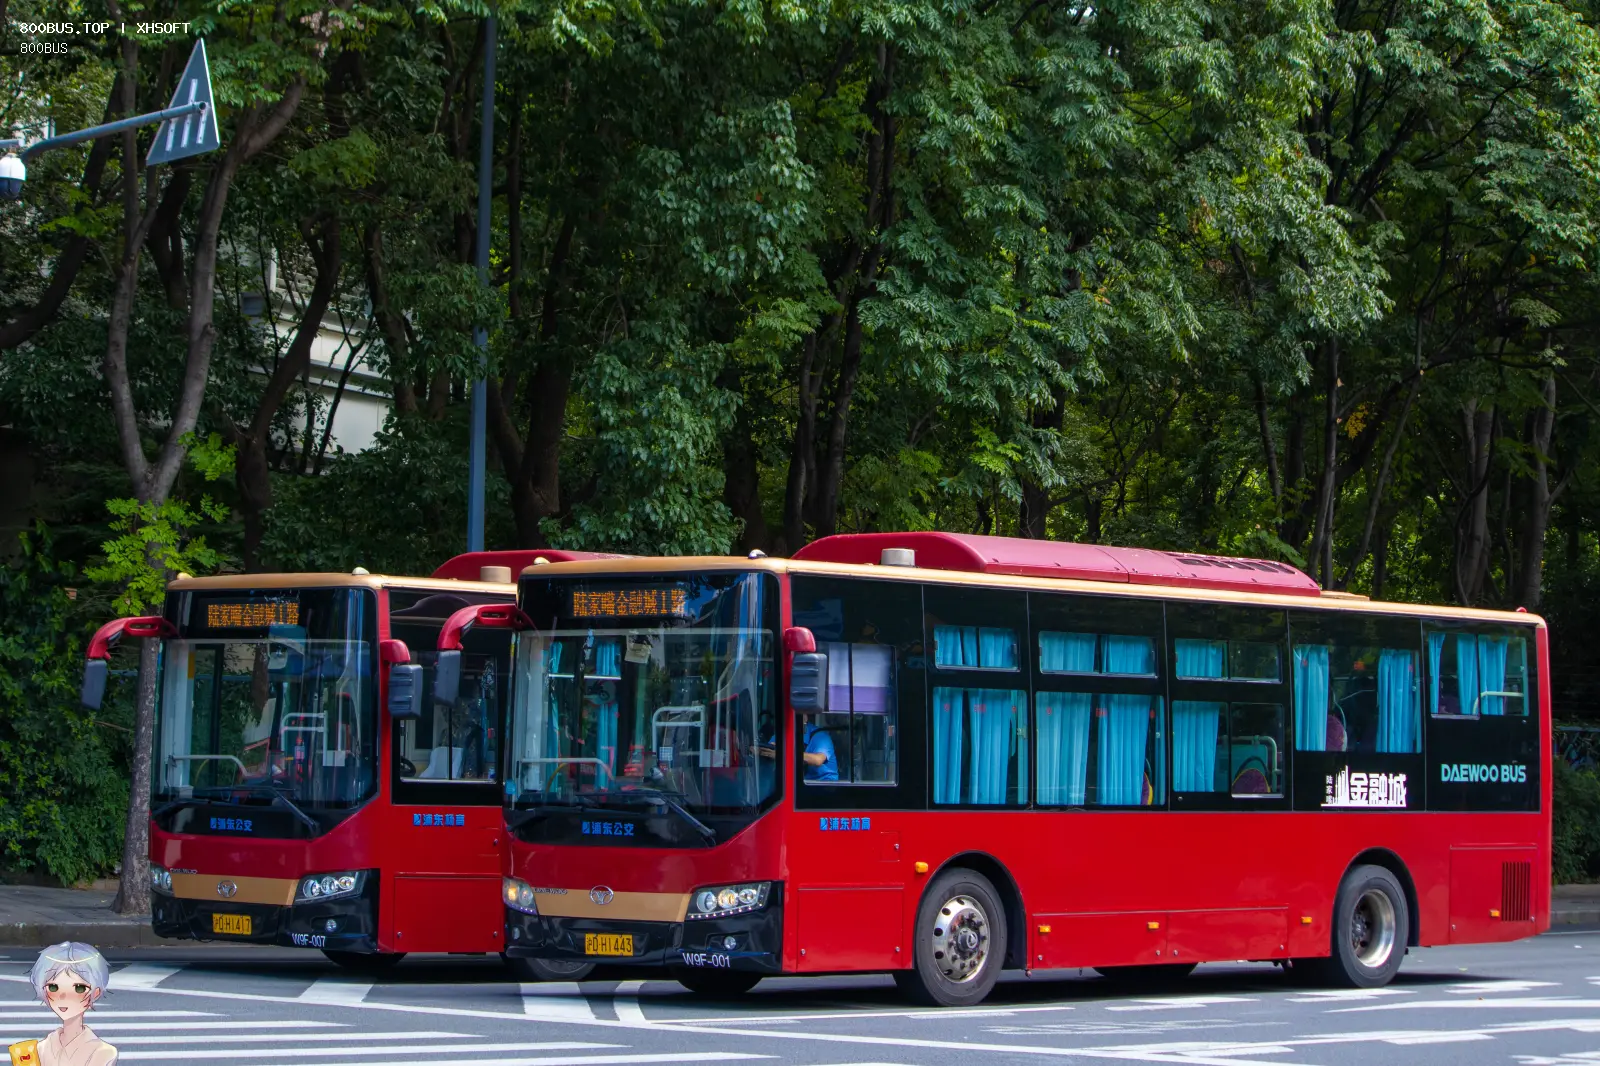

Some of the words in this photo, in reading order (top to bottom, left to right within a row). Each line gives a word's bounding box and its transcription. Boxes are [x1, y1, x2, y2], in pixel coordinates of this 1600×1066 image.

[1441, 764, 1499, 782] DAEWOO
[1501, 764, 1526, 782] BUS
[1350, 772, 1406, 806] 金融城
[591, 821, 634, 836] 浦东公交
[291, 933, 326, 948] W9F-007
[682, 953, 731, 968] W9F-001
